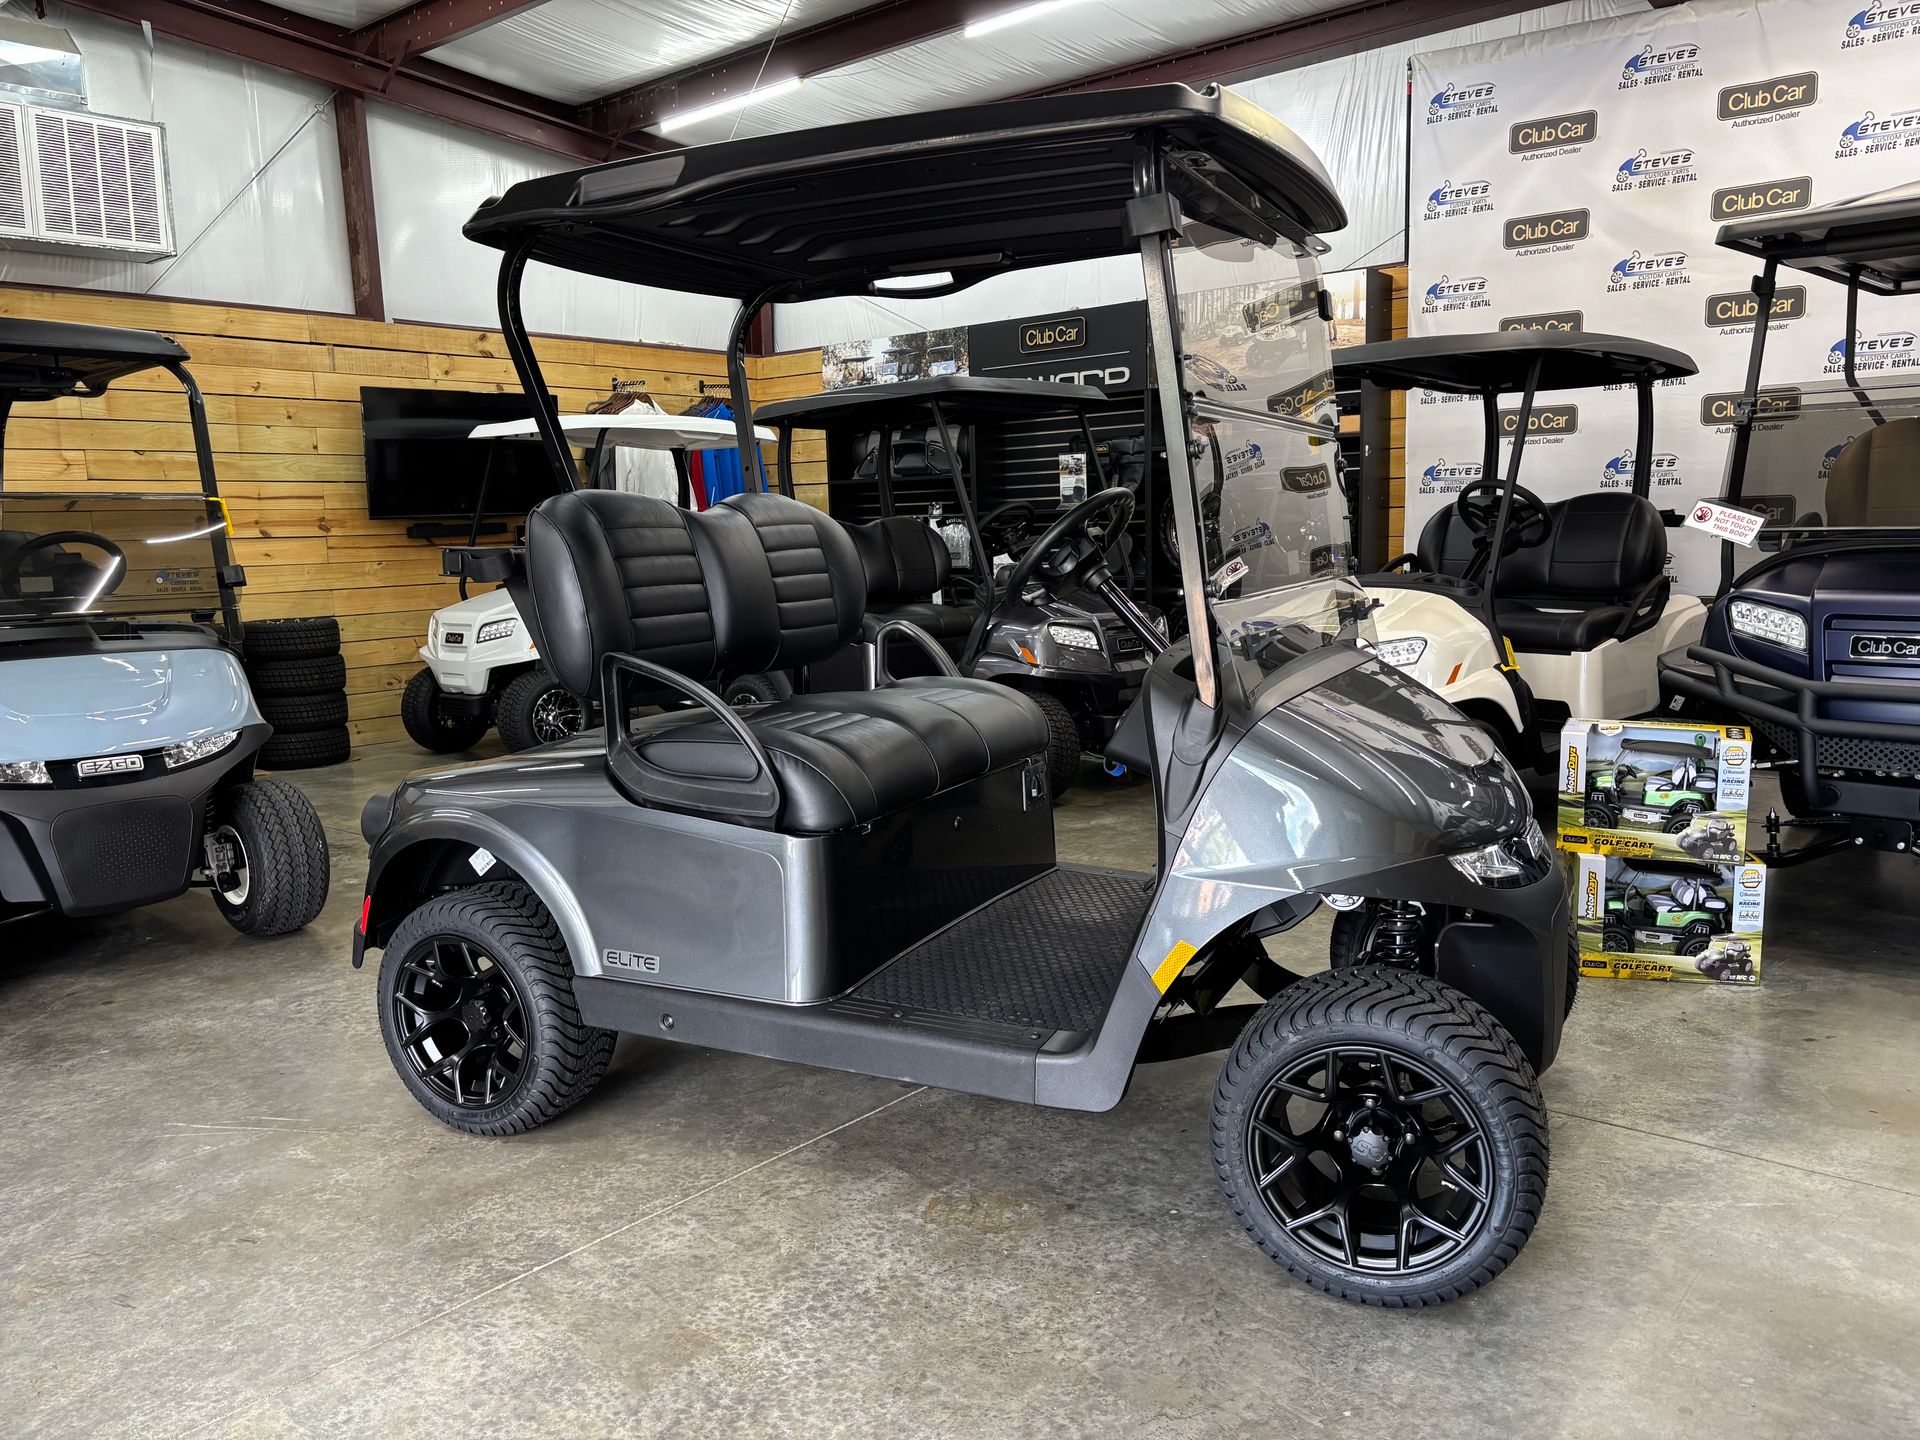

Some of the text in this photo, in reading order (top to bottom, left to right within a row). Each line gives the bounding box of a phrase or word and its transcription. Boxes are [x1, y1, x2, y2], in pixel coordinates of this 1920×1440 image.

[1879, 20, 1910, 33] CUSTOM
[1841, 38, 1865, 50] SALES
[1872, 29, 1904, 43] SERVICE
[1639, 48, 1698, 67] STEVE'S
[1650, 63, 1695, 76] CUSTOM CARTS
[1618, 68, 1703, 90] SALES SERVICE RENTAL
[1443, 86, 1494, 103] STEVE'S
[1728, 84, 1807, 111] Club Car
[1453, 100, 1492, 112] CUSTOM CARTS
[1427, 105, 1498, 125] SALES SERVICE RENTAL
[1732, 111, 1801, 129] Authorized Dealer
[1519, 122, 1588, 145] Club Car
[1872, 133, 1903, 144] CUSTOM
[1521, 146, 1582, 162] Authorized Dealer
[1835, 148, 1858, 159] SALES
[1865, 140, 1897, 154] SERVICE
[1633, 153, 1692, 171] STEVE'S
[1644, 168, 1689, 179] CUSTOM CARTS
[1612, 173, 1697, 192] SALES SERVICE RENTAL
[1440, 185, 1489, 200] STEVE'S
[1450, 201, 1471, 209] CUSTOM
[1722, 188, 1801, 213] Club Car
[1424, 203, 1494, 221] SALES SERVICE RENTAL
[1512, 219, 1580, 241] Club Car
[1515, 244, 1575, 257] Authorized Dealer
[1627, 256, 1686, 271] STEVE'S
[1638, 270, 1683, 281] CUSTOM CARTS
[1438, 281, 1486, 295] STEVE'S
[1607, 276, 1691, 293] SALES SERVICE RENTAL
[1422, 300, 1491, 314] SALES SERVICE RENTAL
[1716, 299, 1758, 318] Club
[1026, 326, 1078, 345] Club Car
[1720, 326, 1756, 336] Authorize
[1854, 361, 1884, 371] SERVICE
[1892, 358, 1920, 368] RENTAL
[1860, 354, 1889, 362] CUSTOM
[1603, 384, 1622, 392] SALES
[1662, 379, 1686, 387] RENTAL
[1421, 396, 1437, 405] SALES
[1441, 395, 1463, 404] SERVICE
[1541, 413, 1569, 429] Car
[1758, 424, 1784, 432] Dealer
[1542, 437, 1564, 445] Dealer
[1435, 467, 1482, 477] STEVE'S
[1419, 486, 1435, 494] SALES
[1440, 485, 1462, 494] SERVICE
[1600, 480, 1619, 488] SALES
[1658, 478, 1682, 486] RENTAL
[1714, 517, 1755, 533] NOT TOUCH
[1720, 511, 1758, 526] PLEASE DO
[1713, 524, 1749, 539] THIS BODY
[1858, 640, 1920, 655] Club Car
[82, 758, 141, 774] EZGO
[1566, 746, 1577, 794] MotorDayz
[1624, 840, 1654, 850] CART
[1586, 872, 1597, 920] MotorDayz
[1644, 964, 1674, 972] CART
